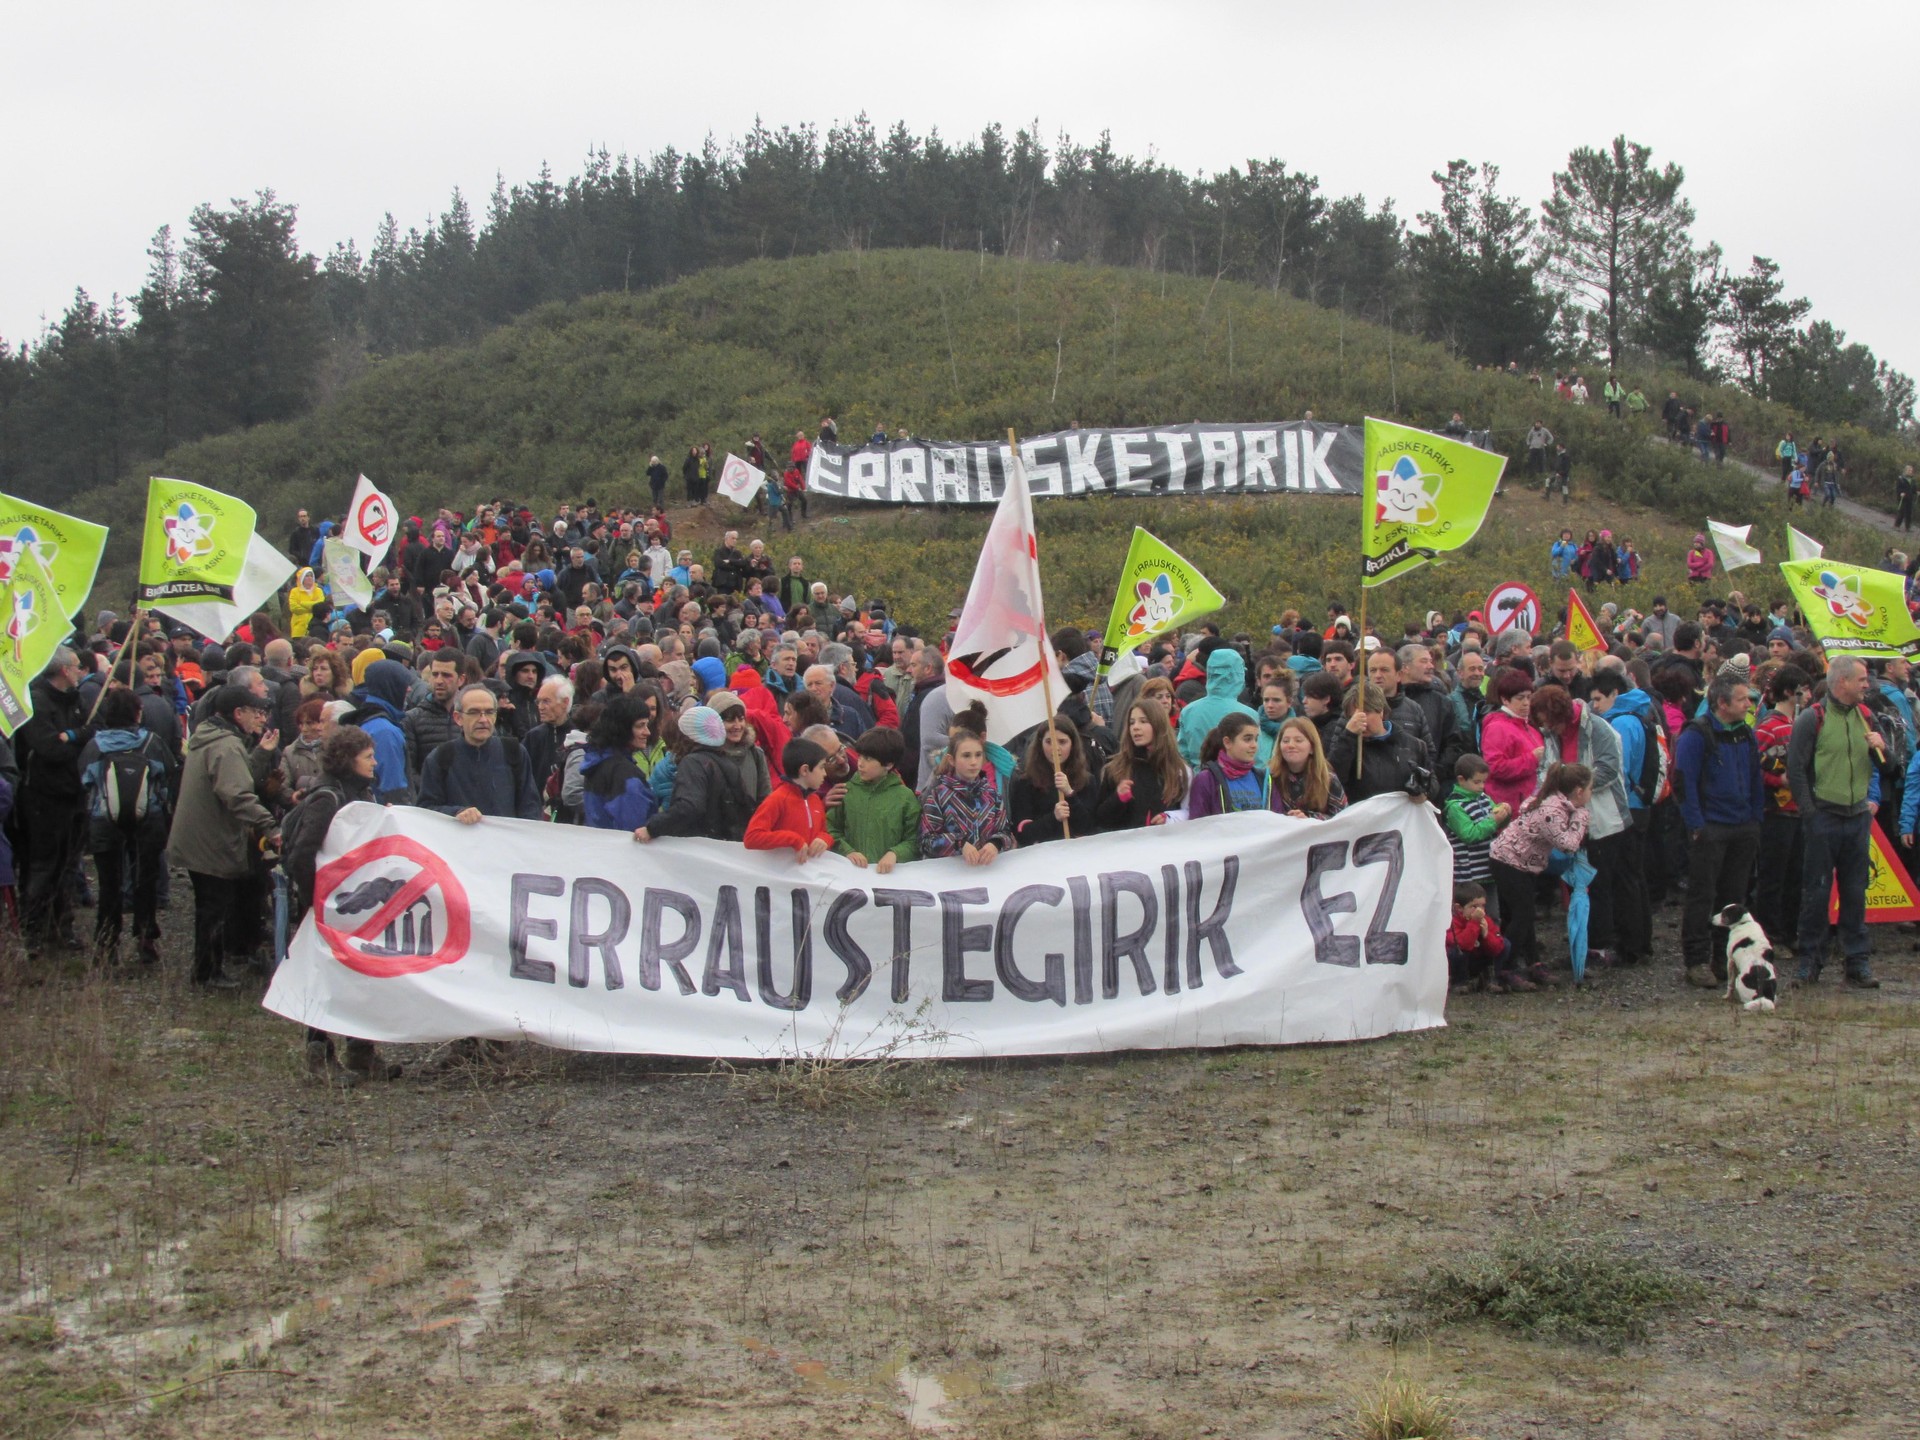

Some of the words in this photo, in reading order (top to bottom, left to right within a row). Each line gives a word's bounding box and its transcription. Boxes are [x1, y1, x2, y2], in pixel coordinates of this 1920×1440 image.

[808, 431, 1342, 502] ERRAUSKETARIK
[1133, 558, 1194, 602] ERRAUSKETARIK?
[508, 855, 1244, 1012] ERRAUSTEGIRIK
[1300, 829, 1410, 968] EZ
